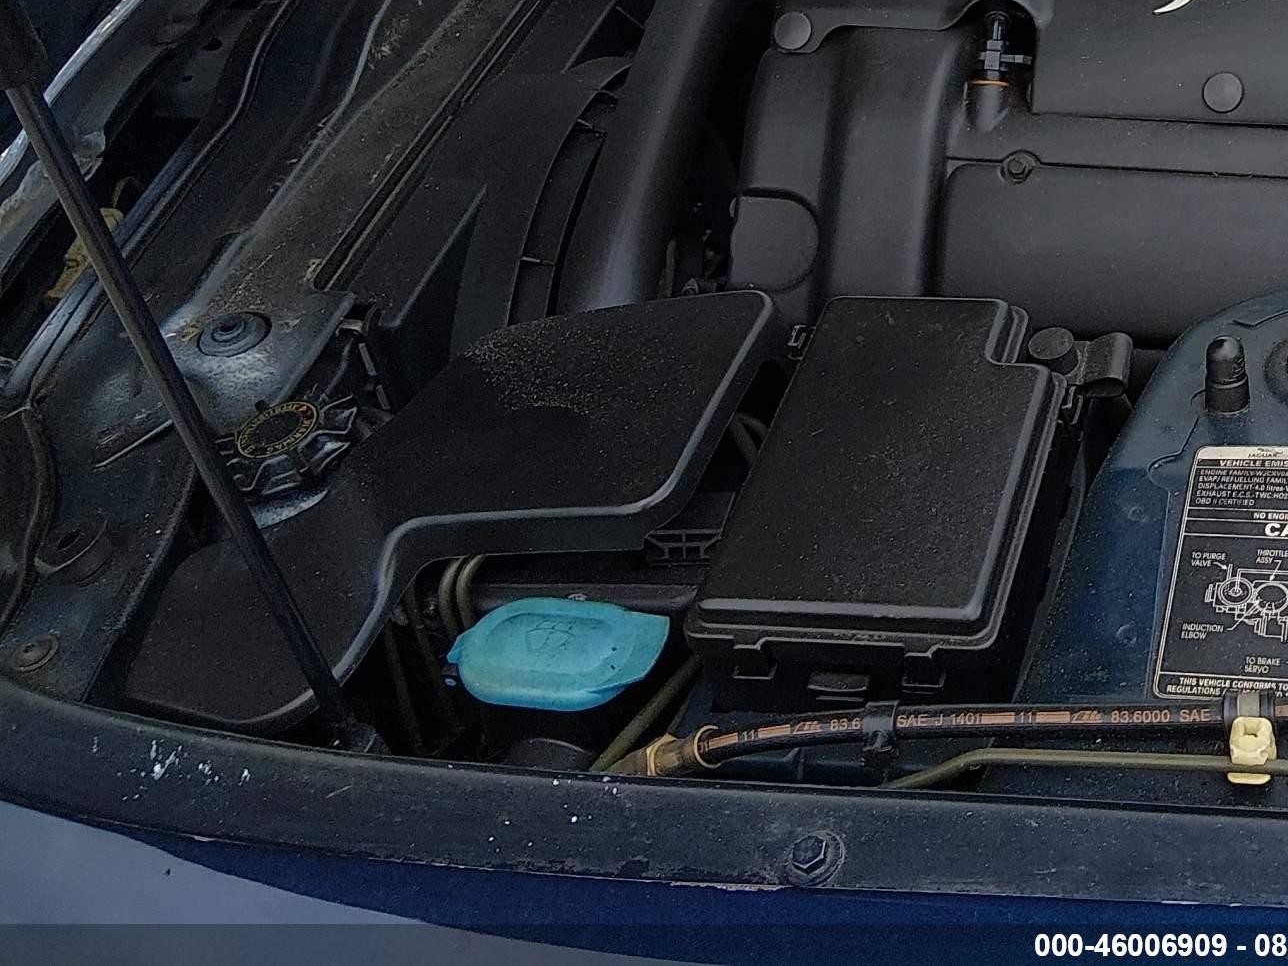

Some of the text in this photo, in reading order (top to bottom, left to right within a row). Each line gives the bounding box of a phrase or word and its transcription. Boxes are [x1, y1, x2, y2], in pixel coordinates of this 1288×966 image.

[1221, 476, 1265, 484] REFUELLING
[1195, 497, 1211, 505] OBD
[1219, 498, 1255, 506] CERTIFIED
[1192, 551, 1226, 560] TO PURGE
[1257, 549, 1288, 558] THROTTLE
[1191, 559, 1212, 567] VALVE
[1182, 623, 1224, 632] INDUCTION
[1181, 631, 1208, 640] ELBOW
[1245, 656, 1281, 666] TO BRAKE
[1244, 665, 1269, 674] SERVO
[1179, 677, 1197, 686] THIS
[1199, 678, 1231, 687] VEHICLE
[1232, 680, 1276, 690] CONFORMS
[1278, 683, 1288, 691] TO
[1166, 684, 1221, 695] REGULATIONS
[897, 714, 928, 727] SAE
[951, 713, 981, 726] 1401
[1180, 709, 1211, 722] SAE
